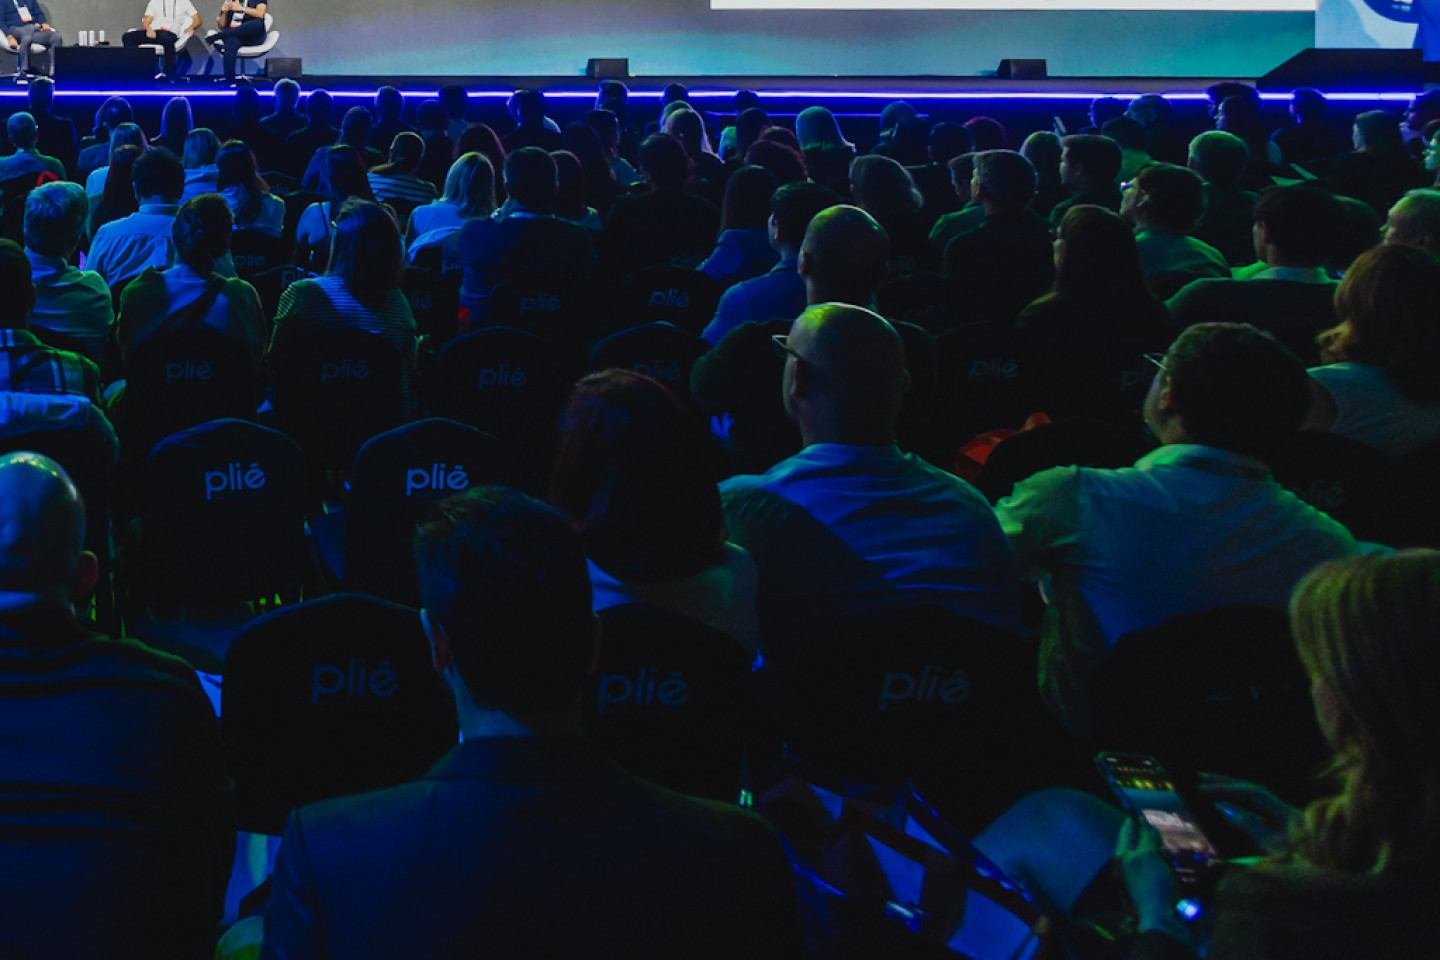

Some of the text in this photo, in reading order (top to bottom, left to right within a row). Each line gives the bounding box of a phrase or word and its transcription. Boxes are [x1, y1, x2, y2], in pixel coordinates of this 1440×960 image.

[204, 460, 267, 501] plié
[406, 461, 470, 497] plié
[311, 658, 400, 705] plié
[597, 665, 690, 713] plié
[880, 664, 974, 712] plié
